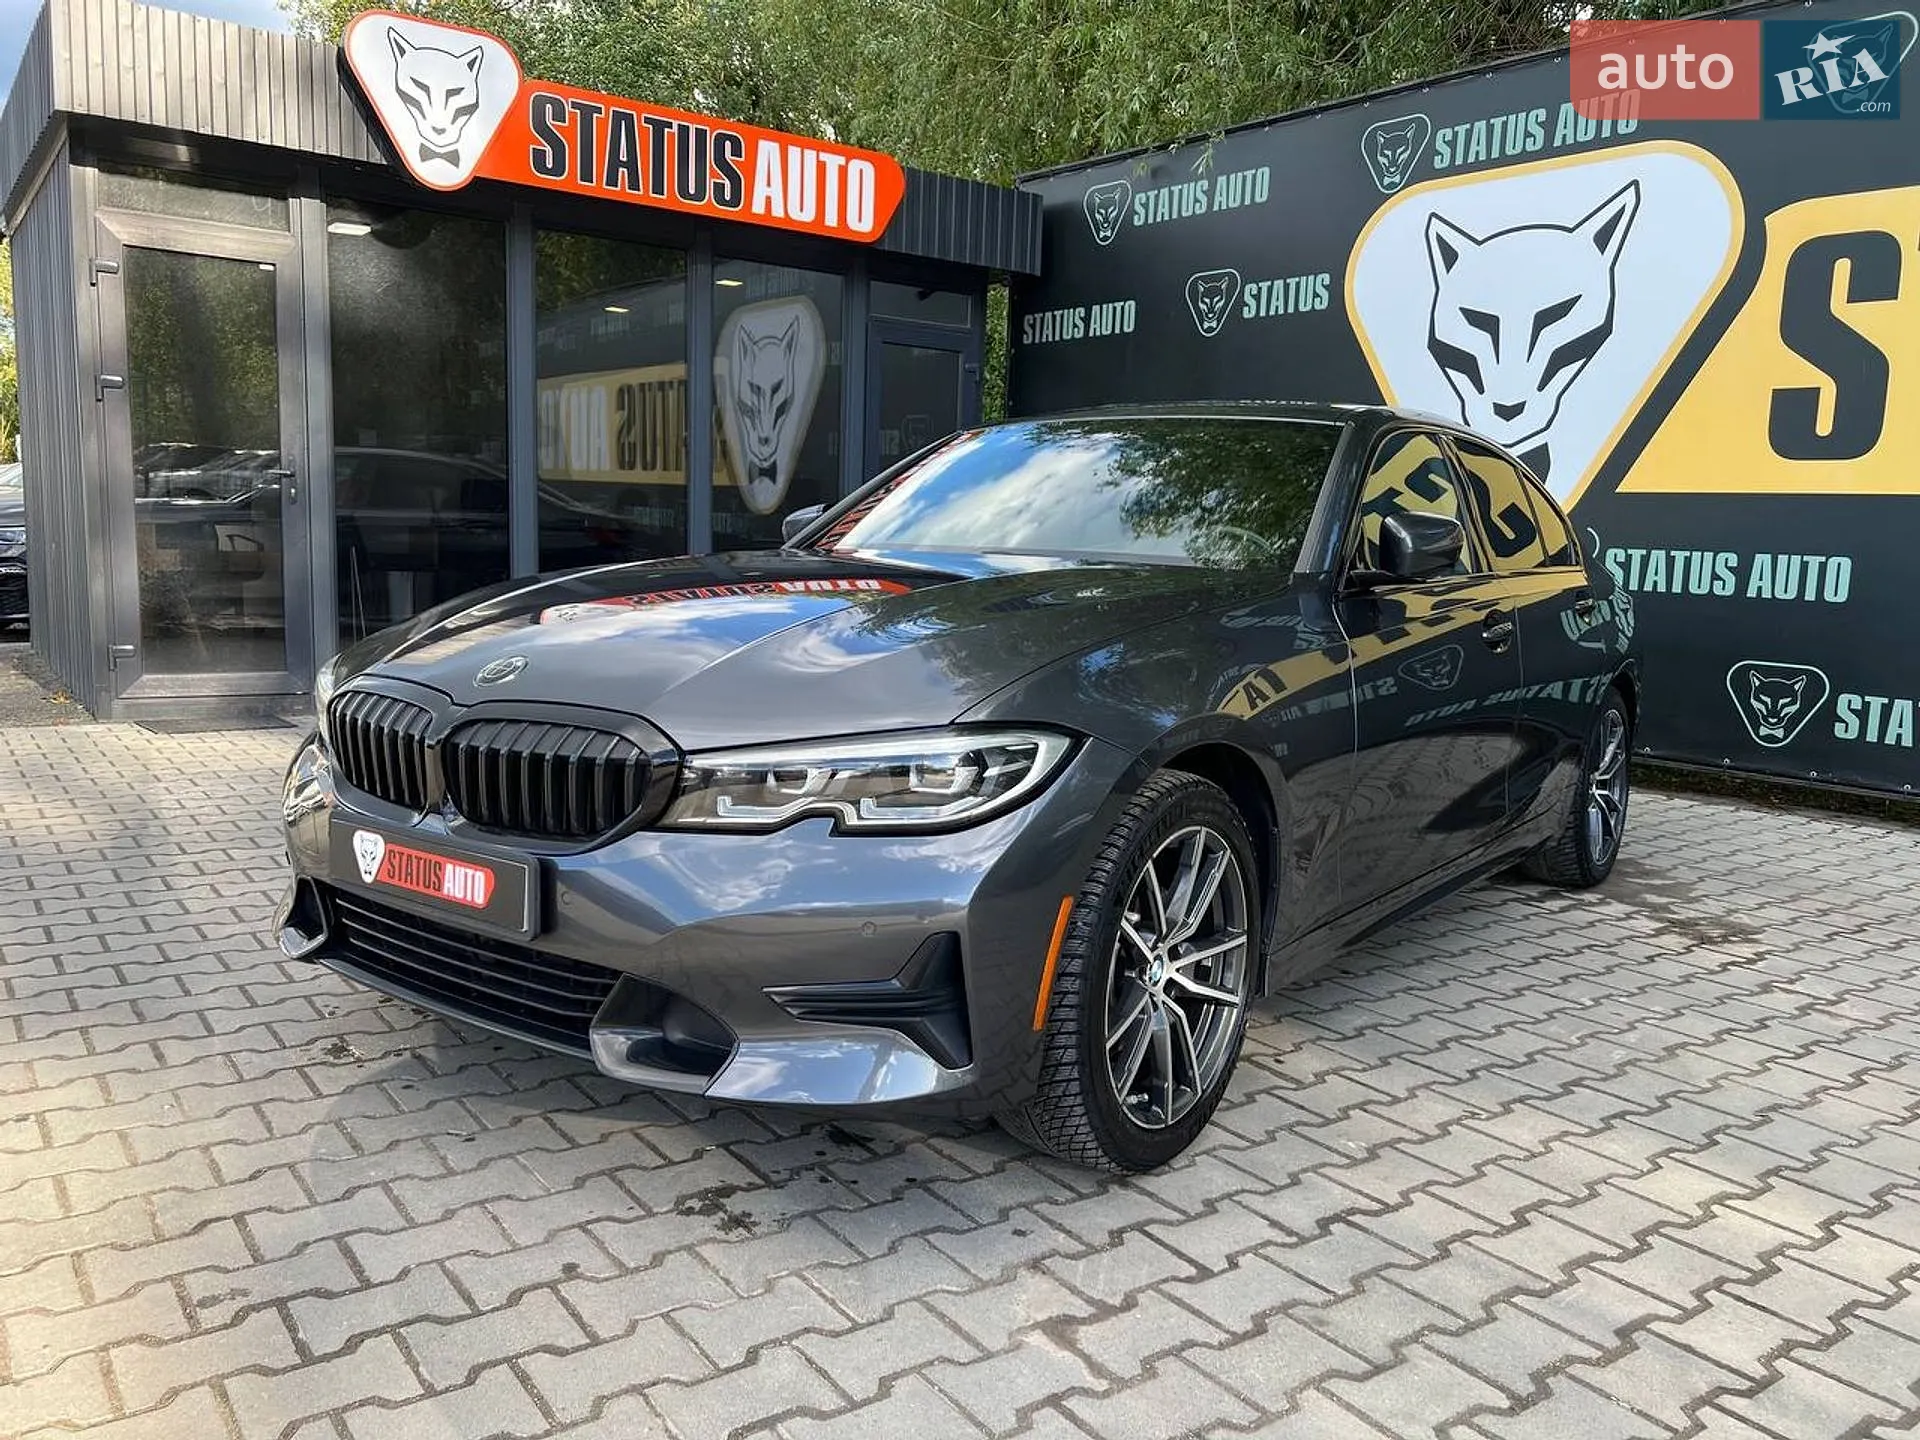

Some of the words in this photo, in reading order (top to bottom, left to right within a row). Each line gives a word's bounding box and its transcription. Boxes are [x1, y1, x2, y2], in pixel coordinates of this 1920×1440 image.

[1434, 108, 1546, 169] STATUS
[1553, 89, 1640, 147] AUTO
[530, 92, 745, 210] STATUS
[751, 140, 875, 234] AUTO
[1133, 180, 1208, 226] STATUS
[1213, 166, 1270, 210] AUTO
[1022, 307, 1085, 344] STATUS
[1089, 300, 1136, 337] AUTO
[1243, 273, 1331, 319] STATUS
[1769, 229, 1920, 461] S
[1604, 548, 1738, 597] STATUS
[1747, 553, 1852, 602] AUTO
[1834, 693, 1920, 748] STA
[388, 849, 442, 891] STATUS
[443, 864, 485, 903] AUTO
